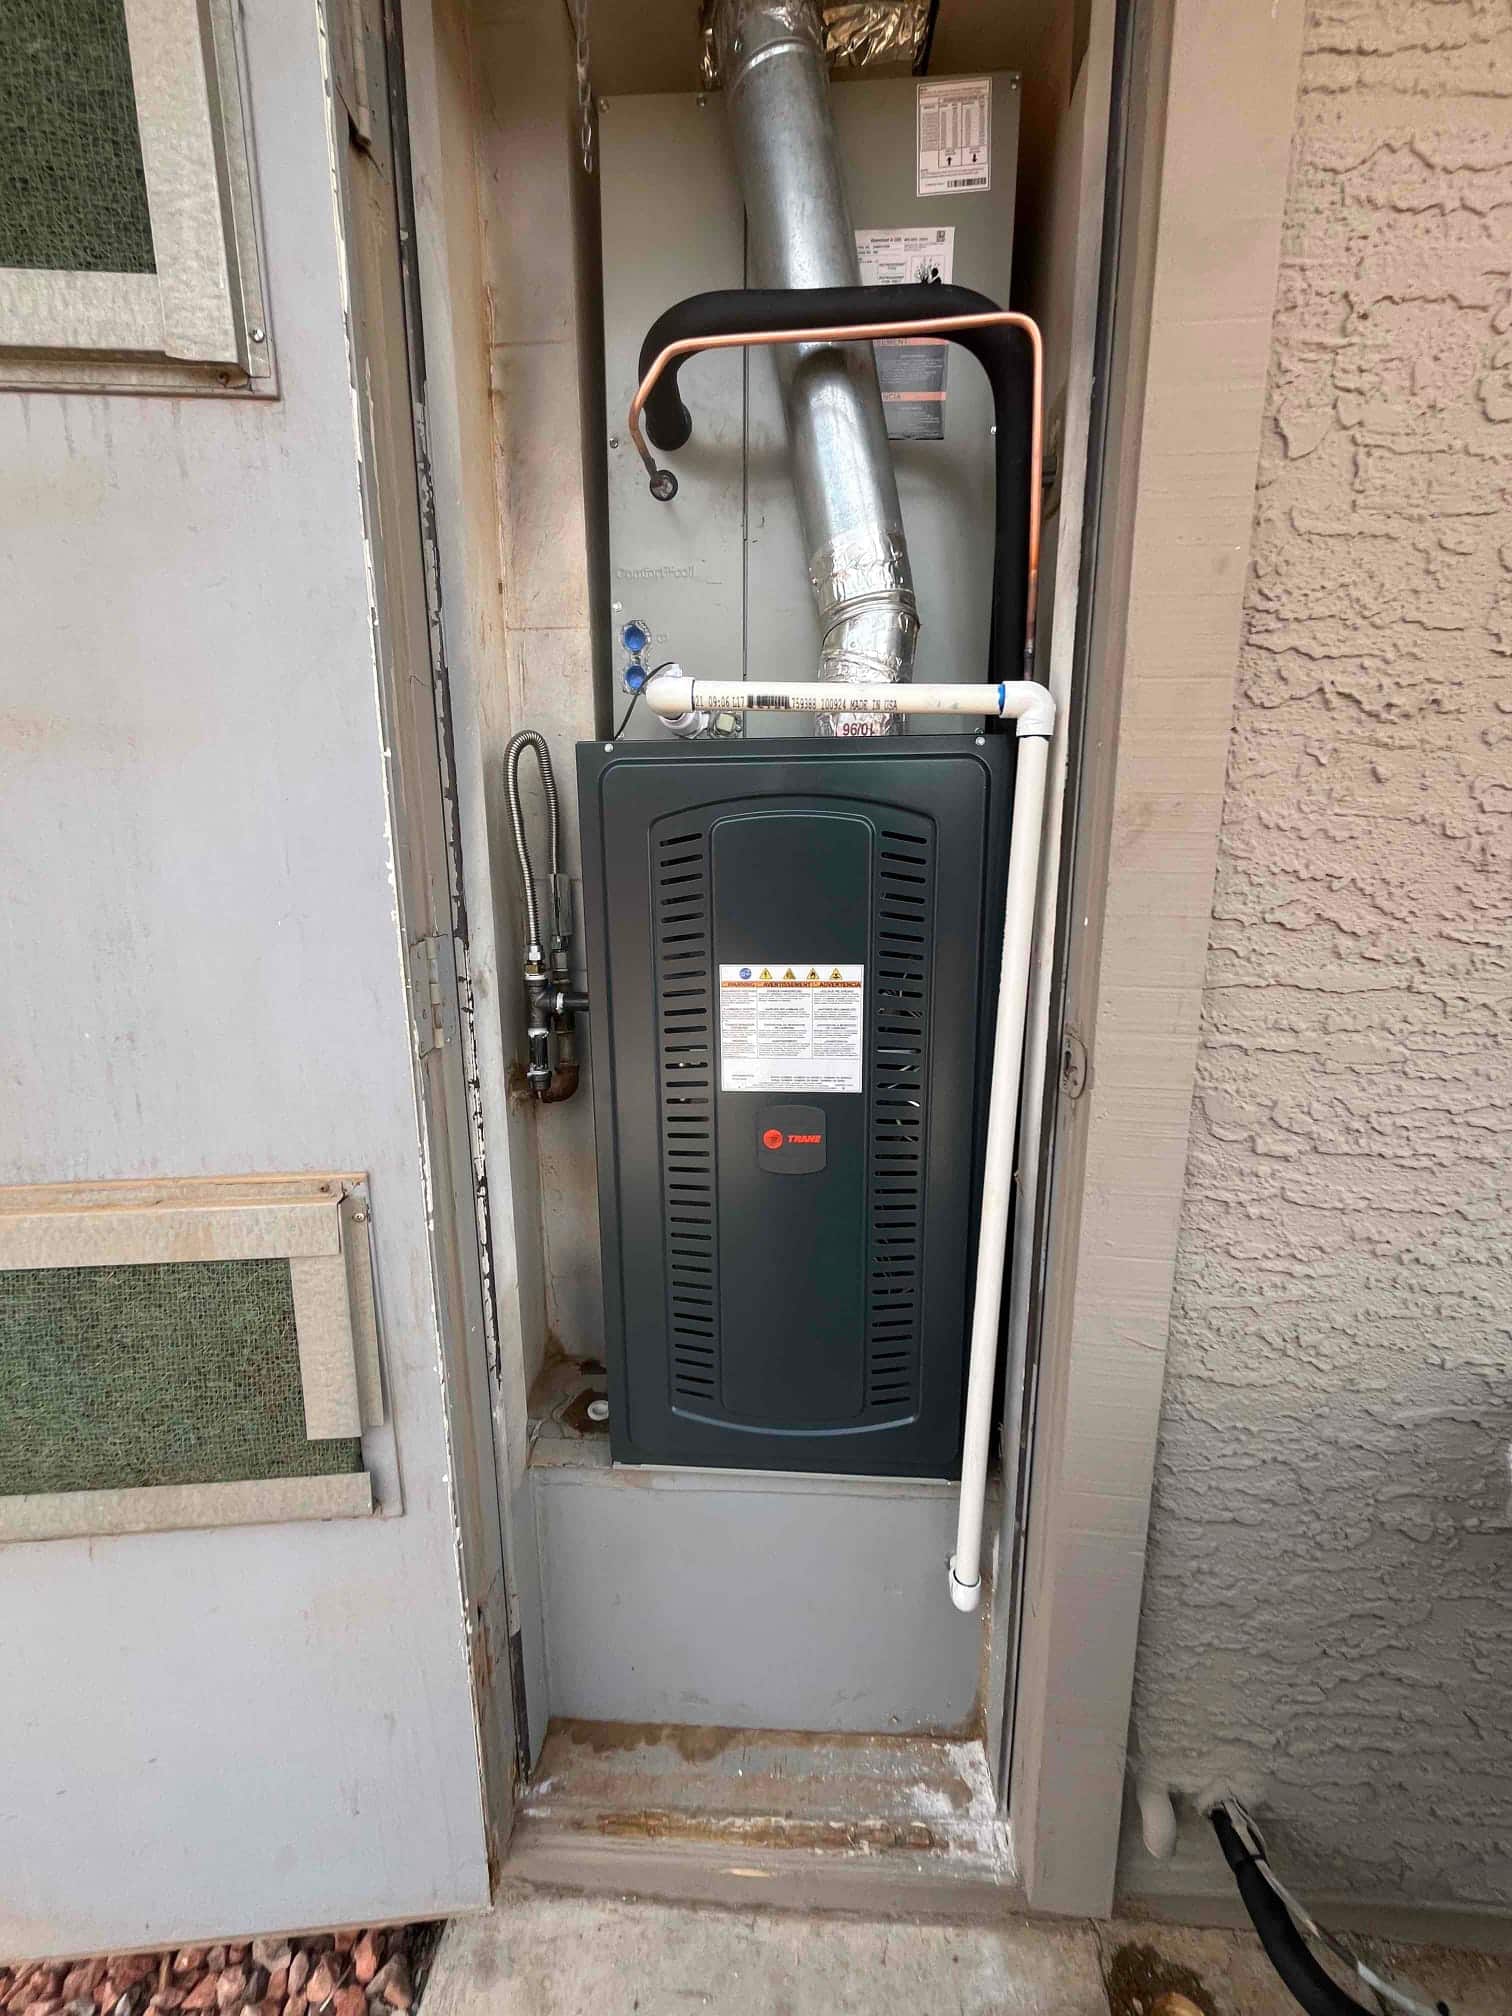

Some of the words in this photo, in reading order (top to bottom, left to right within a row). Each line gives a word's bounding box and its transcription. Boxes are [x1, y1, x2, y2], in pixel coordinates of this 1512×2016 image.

[849, 698, 868, 711] MADE
[872, 698, 881, 711] IN
[884, 698, 898, 711] USA
[787, 1135, 821, 1144] TRANE
